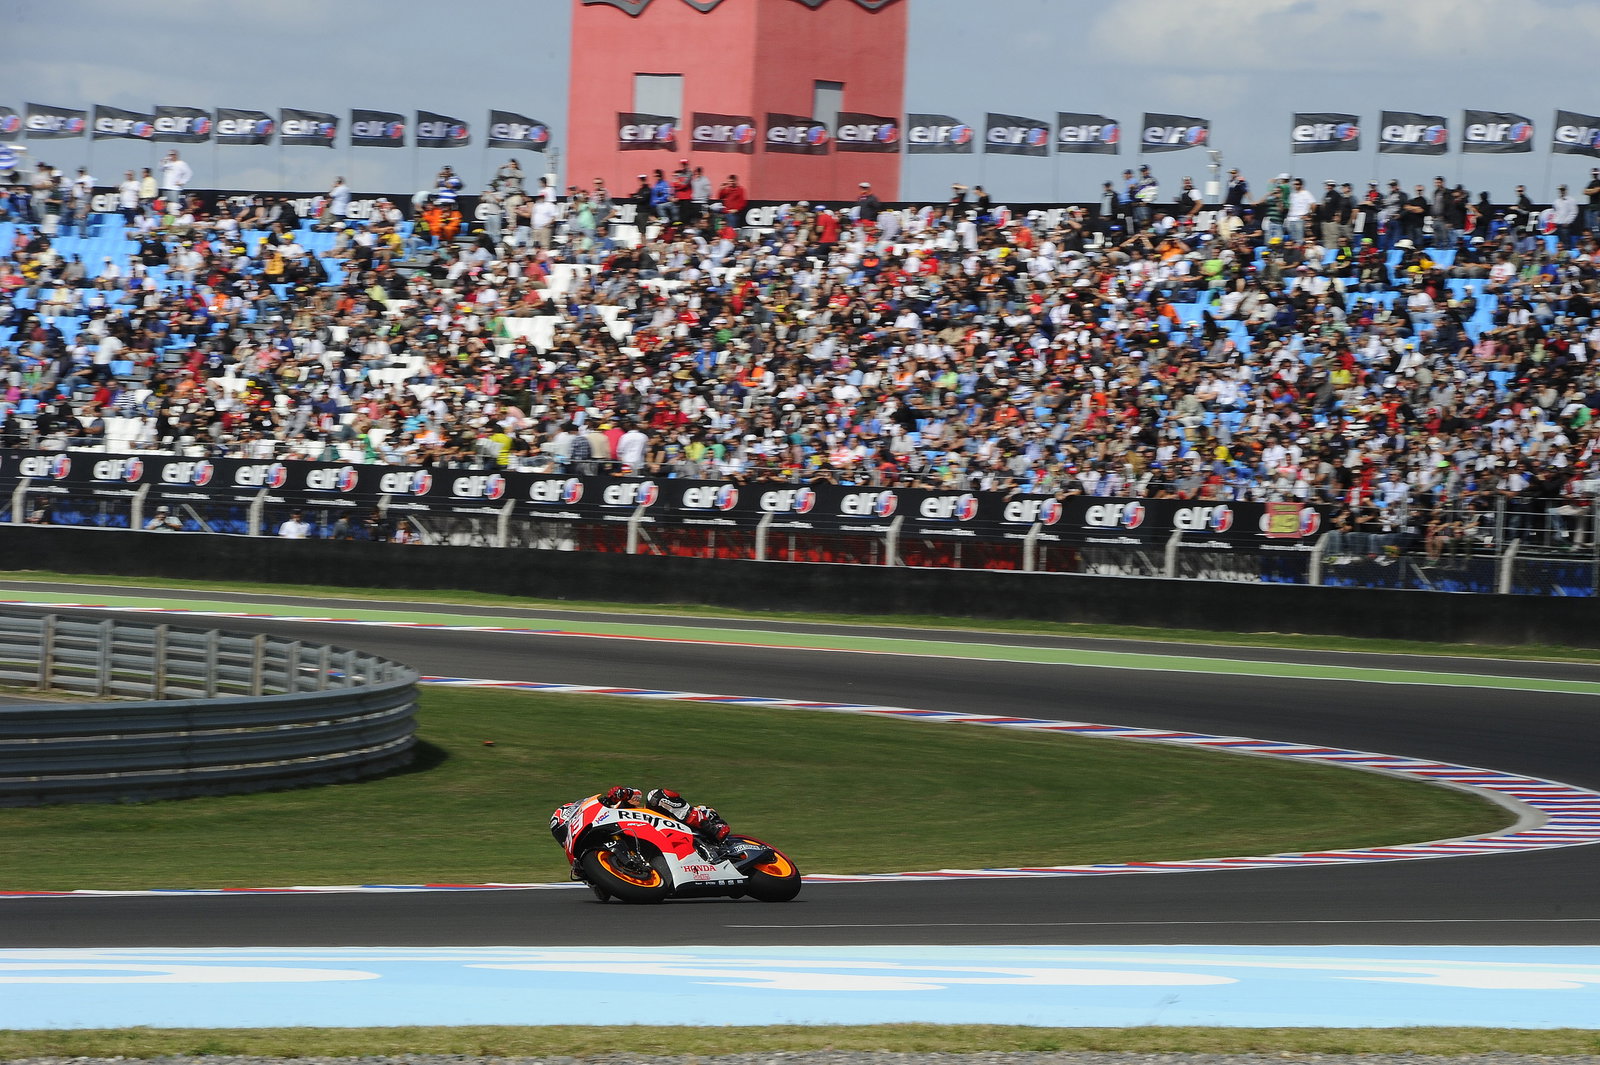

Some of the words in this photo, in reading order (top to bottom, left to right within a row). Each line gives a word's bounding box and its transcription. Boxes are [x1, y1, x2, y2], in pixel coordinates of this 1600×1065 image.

[154, 116, 192, 132] elf
[217, 118, 257, 135] elf
[281, 118, 320, 135] elf
[490, 121, 530, 138] elf
[620, 123, 659, 140] elf
[693, 123, 735, 140] elf
[766, 124, 808, 142] elf
[837, 123, 880, 141] elf
[908, 124, 953, 142] elf
[1060, 124, 1102, 142] elf
[1143, 124, 1188, 143] elf
[1292, 123, 1336, 141] elf
[1381, 124, 1427, 142] elf
[1466, 123, 1512, 141] elf
[987, 125, 1029, 143] elf
[19, 456, 54, 476] elf
[93, 459, 126, 480] elf
[162, 461, 196, 484] elf
[235, 464, 270, 486] elf
[306, 468, 341, 490] elf
[379, 471, 414, 493] elf
[452, 475, 487, 498] elf
[529, 479, 565, 502] elf
[603, 482, 639, 505] elf
[683, 486, 718, 508] elf
[760, 489, 796, 512] elf
[840, 492, 877, 516] elf
[920, 495, 957, 518] elf
[1003, 499, 1041, 523] elf
[1085, 503, 1124, 527] elf
[1173, 506, 1211, 530] elf
[684, 865, 717, 873] HONDA
